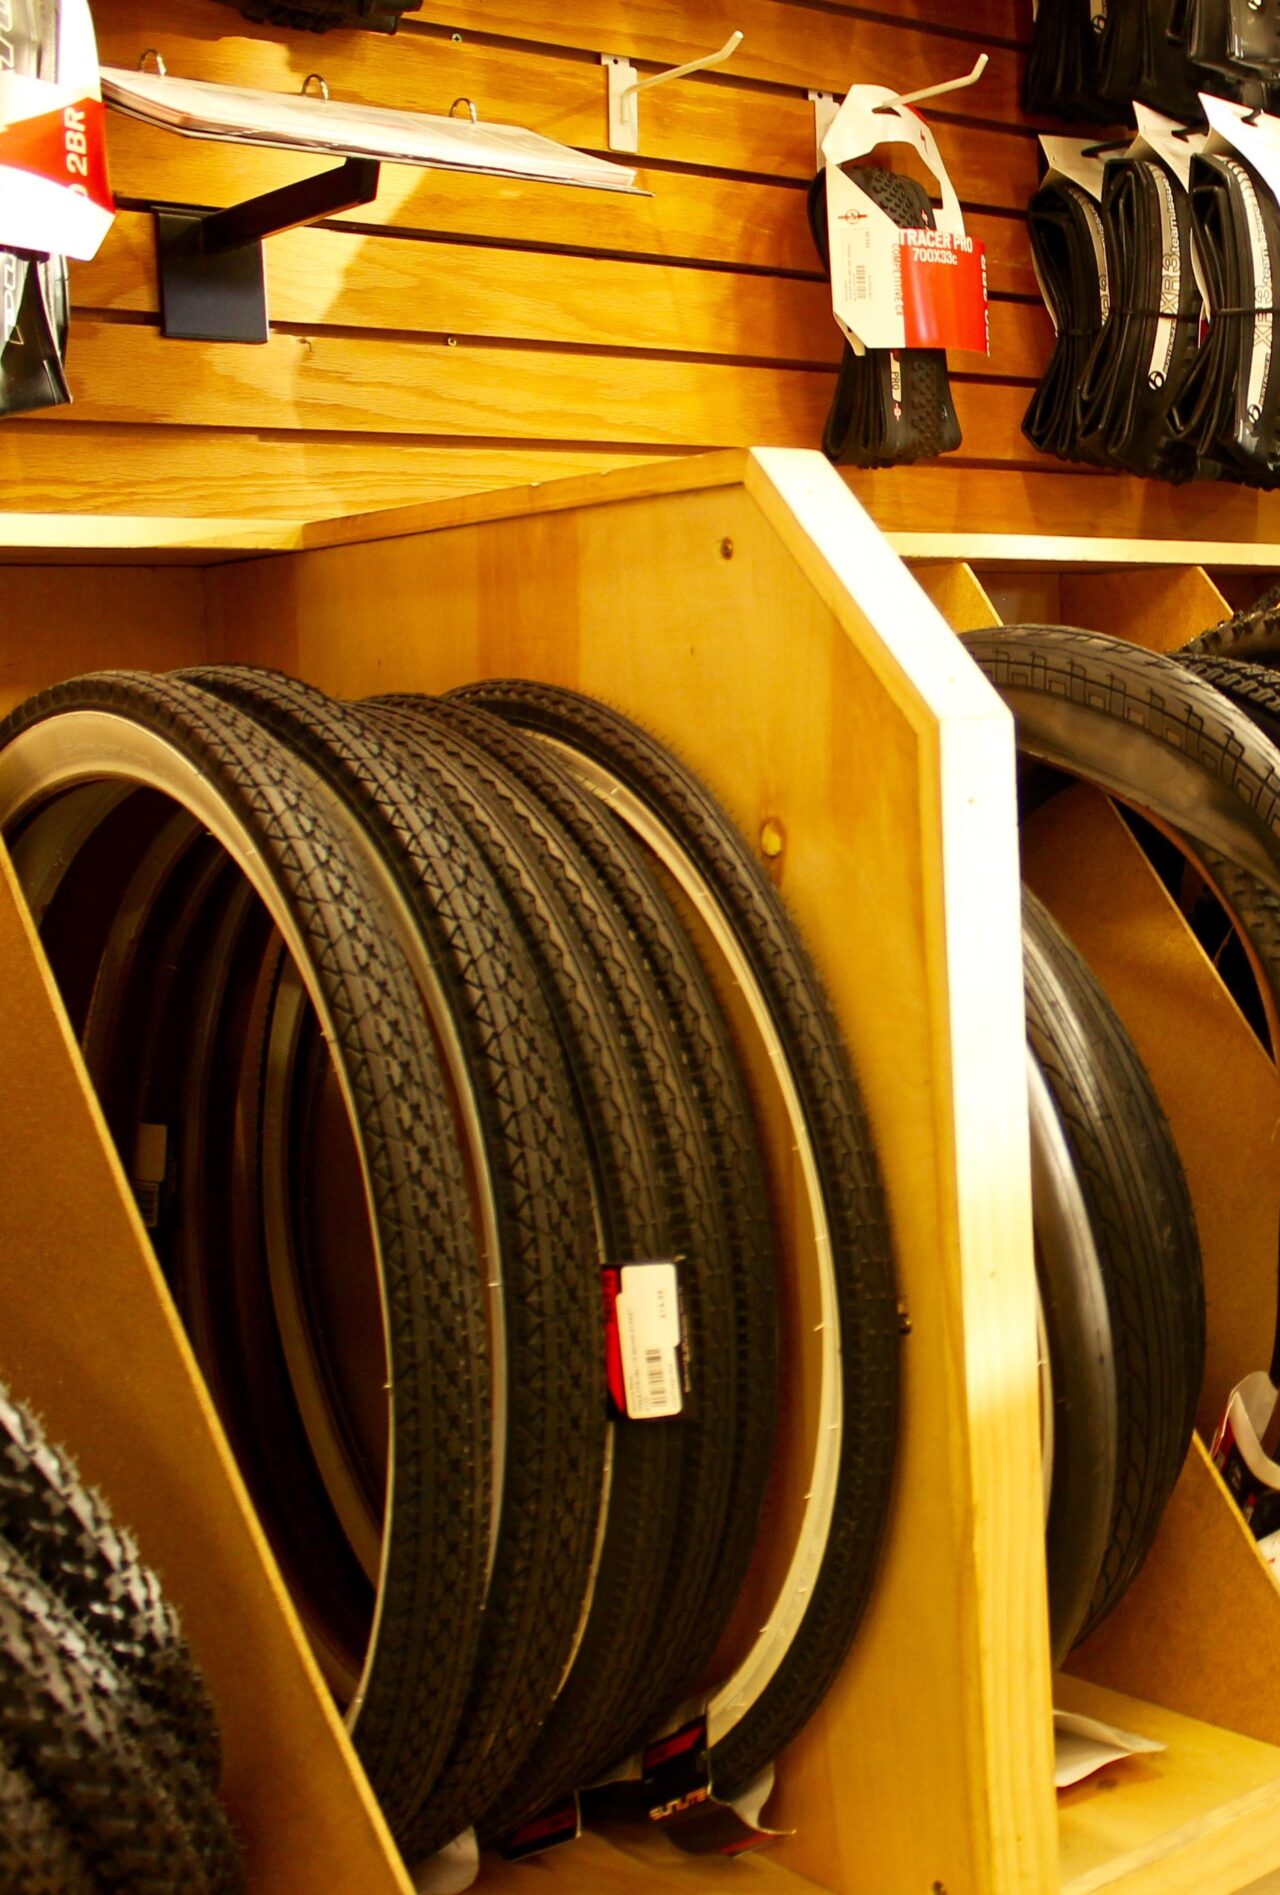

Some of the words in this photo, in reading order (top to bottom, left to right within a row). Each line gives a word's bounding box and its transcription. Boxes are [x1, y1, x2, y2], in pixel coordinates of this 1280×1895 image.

[63, 105, 88, 175] 2BR
[900, 229, 951, 248] TRACER
[953, 234, 973, 253] PRO
[1169, 216, 1182, 251] team
[891, 371, 900, 391] PRO
[649, 1787, 709, 1821] SUNLITE
